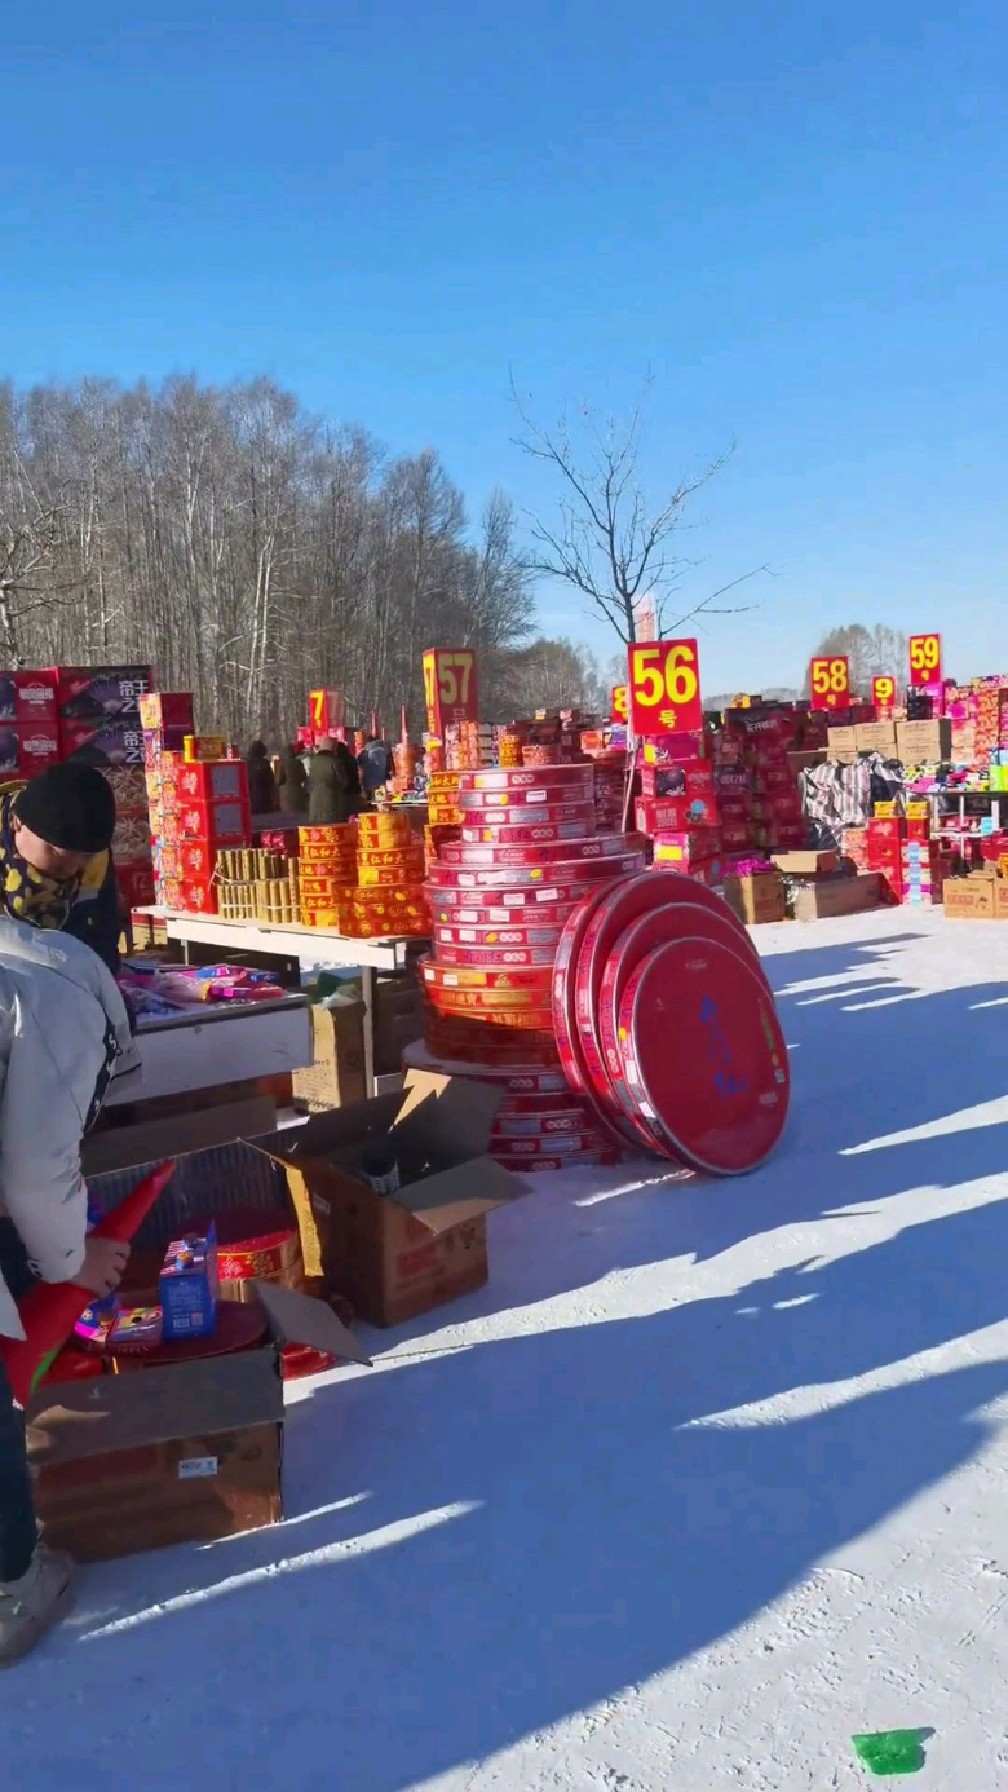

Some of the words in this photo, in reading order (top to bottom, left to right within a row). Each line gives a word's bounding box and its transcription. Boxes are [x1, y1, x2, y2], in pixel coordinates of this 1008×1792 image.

[909, 636, 939, 669] 59
[438, 653, 474, 705] 57
[632, 645, 698, 706] 56
[813, 660, 847, 693] 58
[875, 678, 894, 698] 9
[309, 691, 324, 720] 7
[613, 687, 629, 712] 8
[658, 709, 678, 729] 号
